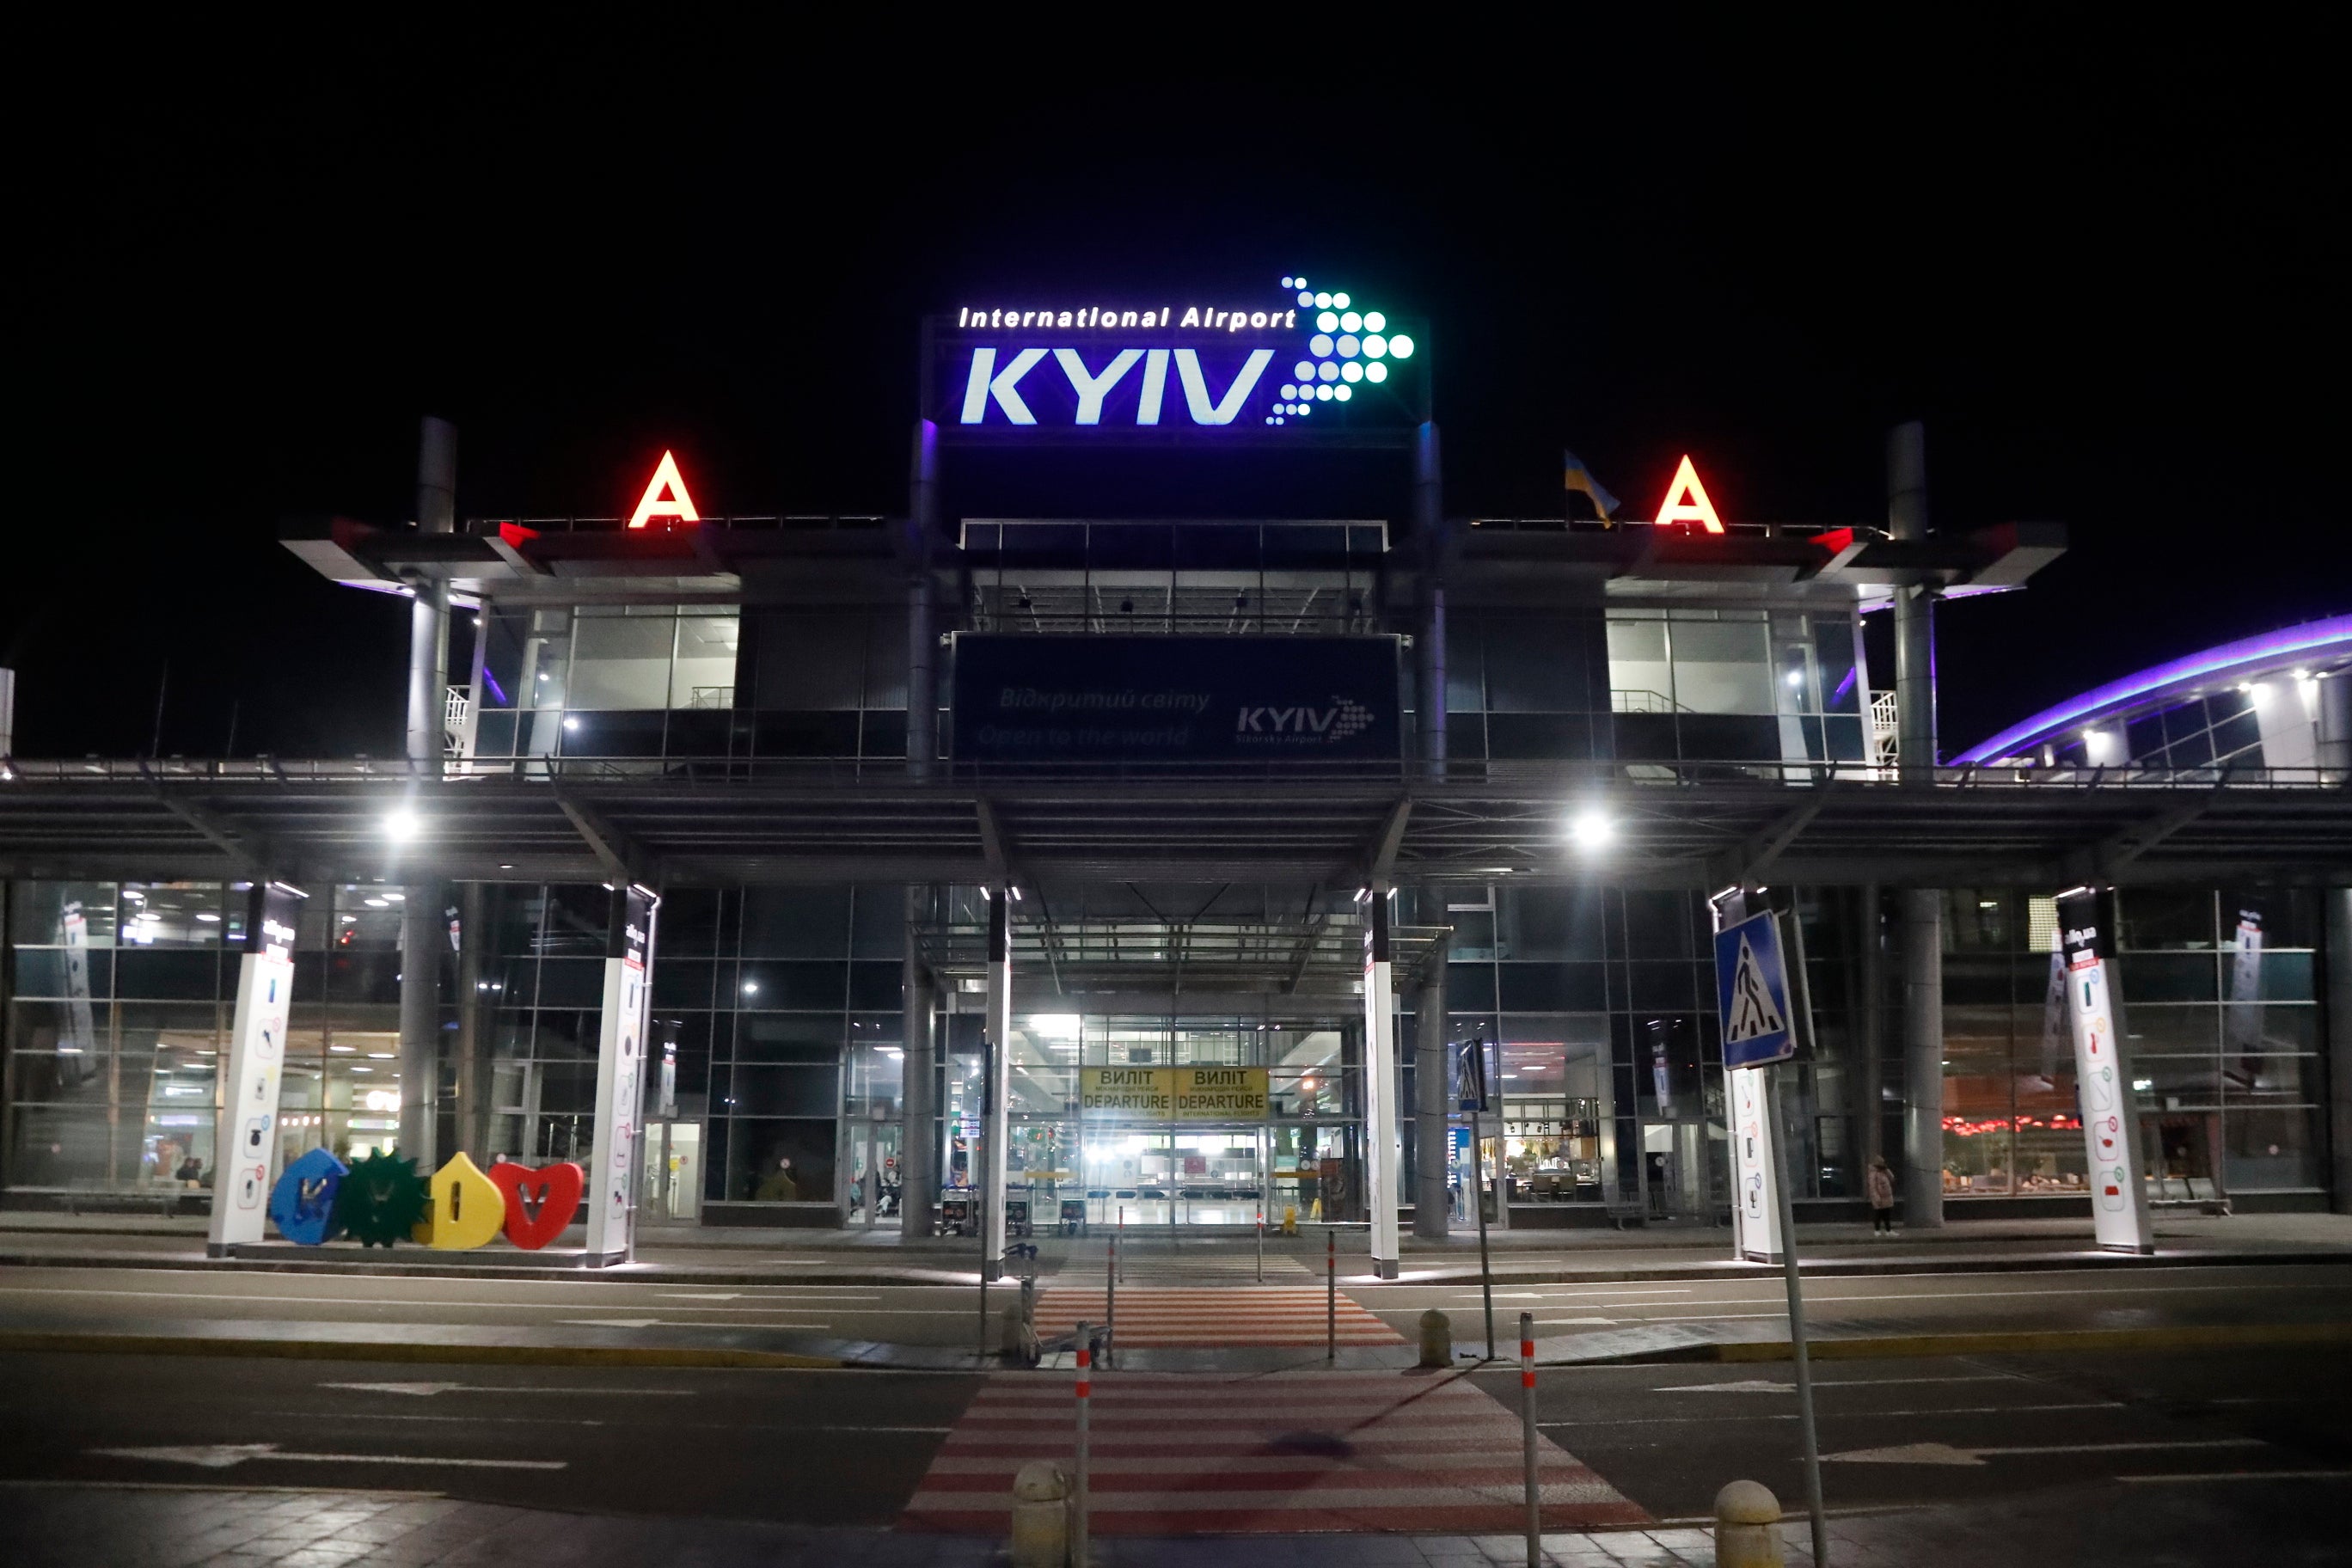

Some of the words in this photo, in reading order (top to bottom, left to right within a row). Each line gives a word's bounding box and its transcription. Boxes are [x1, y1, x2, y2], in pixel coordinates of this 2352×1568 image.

[959, 306, 1170, 328] International
[1180, 306, 1296, 333] Airport
[960, 347, 1276, 426] KYIV
[628, 449, 700, 529] A
[1654, 454, 1725, 534] A
[1000, 687, 1136, 712] Відкритий
[1142, 689, 1210, 714] світу
[1236, 707, 1338, 732] KYIV
[977, 726, 1040, 748] Open
[1077, 726, 1115, 745] the
[1121, 726, 1189, 745] world
[1235, 734, 1282, 745] Sikorsky
[1283, 734, 1323, 745] Airport
[1100, 1070, 1154, 1085] ВИЛІТ
[1195, 1070, 1247, 1085] ВИЛІТ
[1084, 1094, 1170, 1109] DEPARTURE
[1179, 1094, 1264, 1109] DEPARTURE
